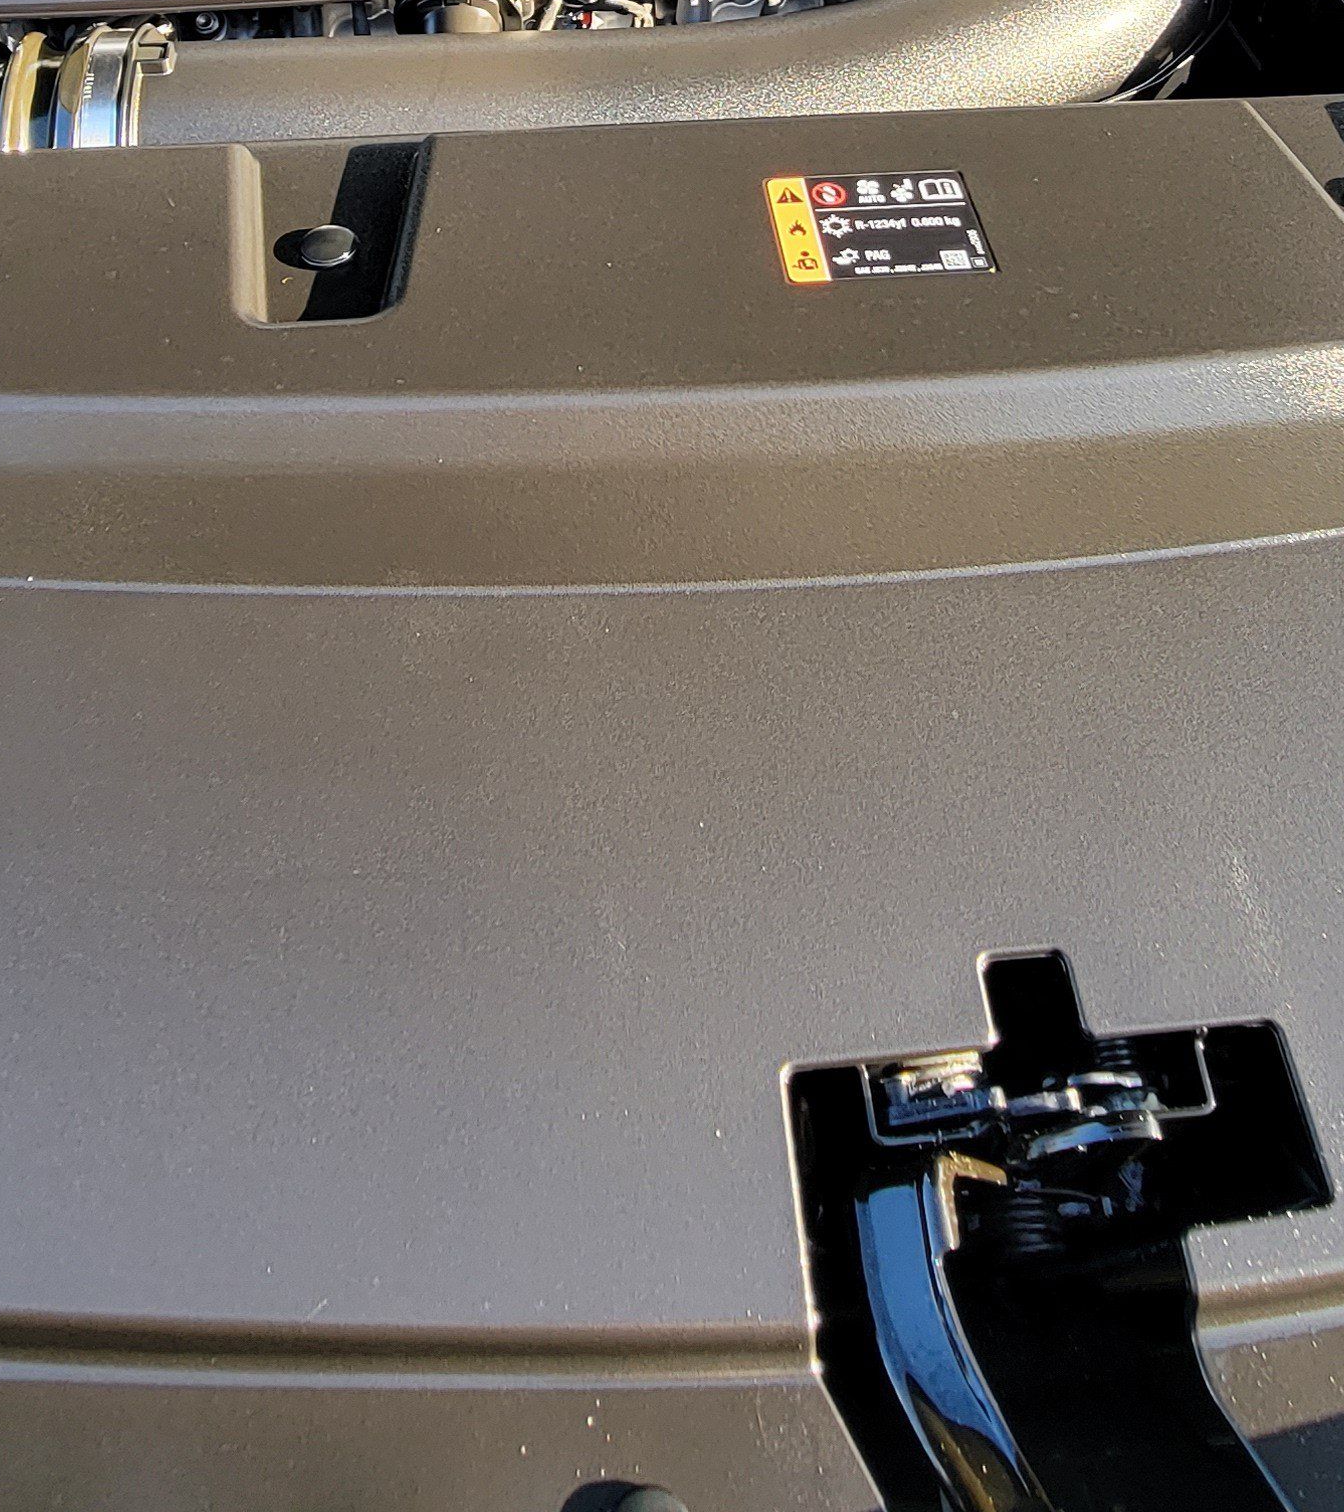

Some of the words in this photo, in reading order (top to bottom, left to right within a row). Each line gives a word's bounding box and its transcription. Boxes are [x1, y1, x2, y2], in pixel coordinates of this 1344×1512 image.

[858, 194, 887, 204] AUTO
[854, 217, 907, 230] R-1234yf
[943, 215, 962, 227] kg
[864, 249, 891, 261] PAG
